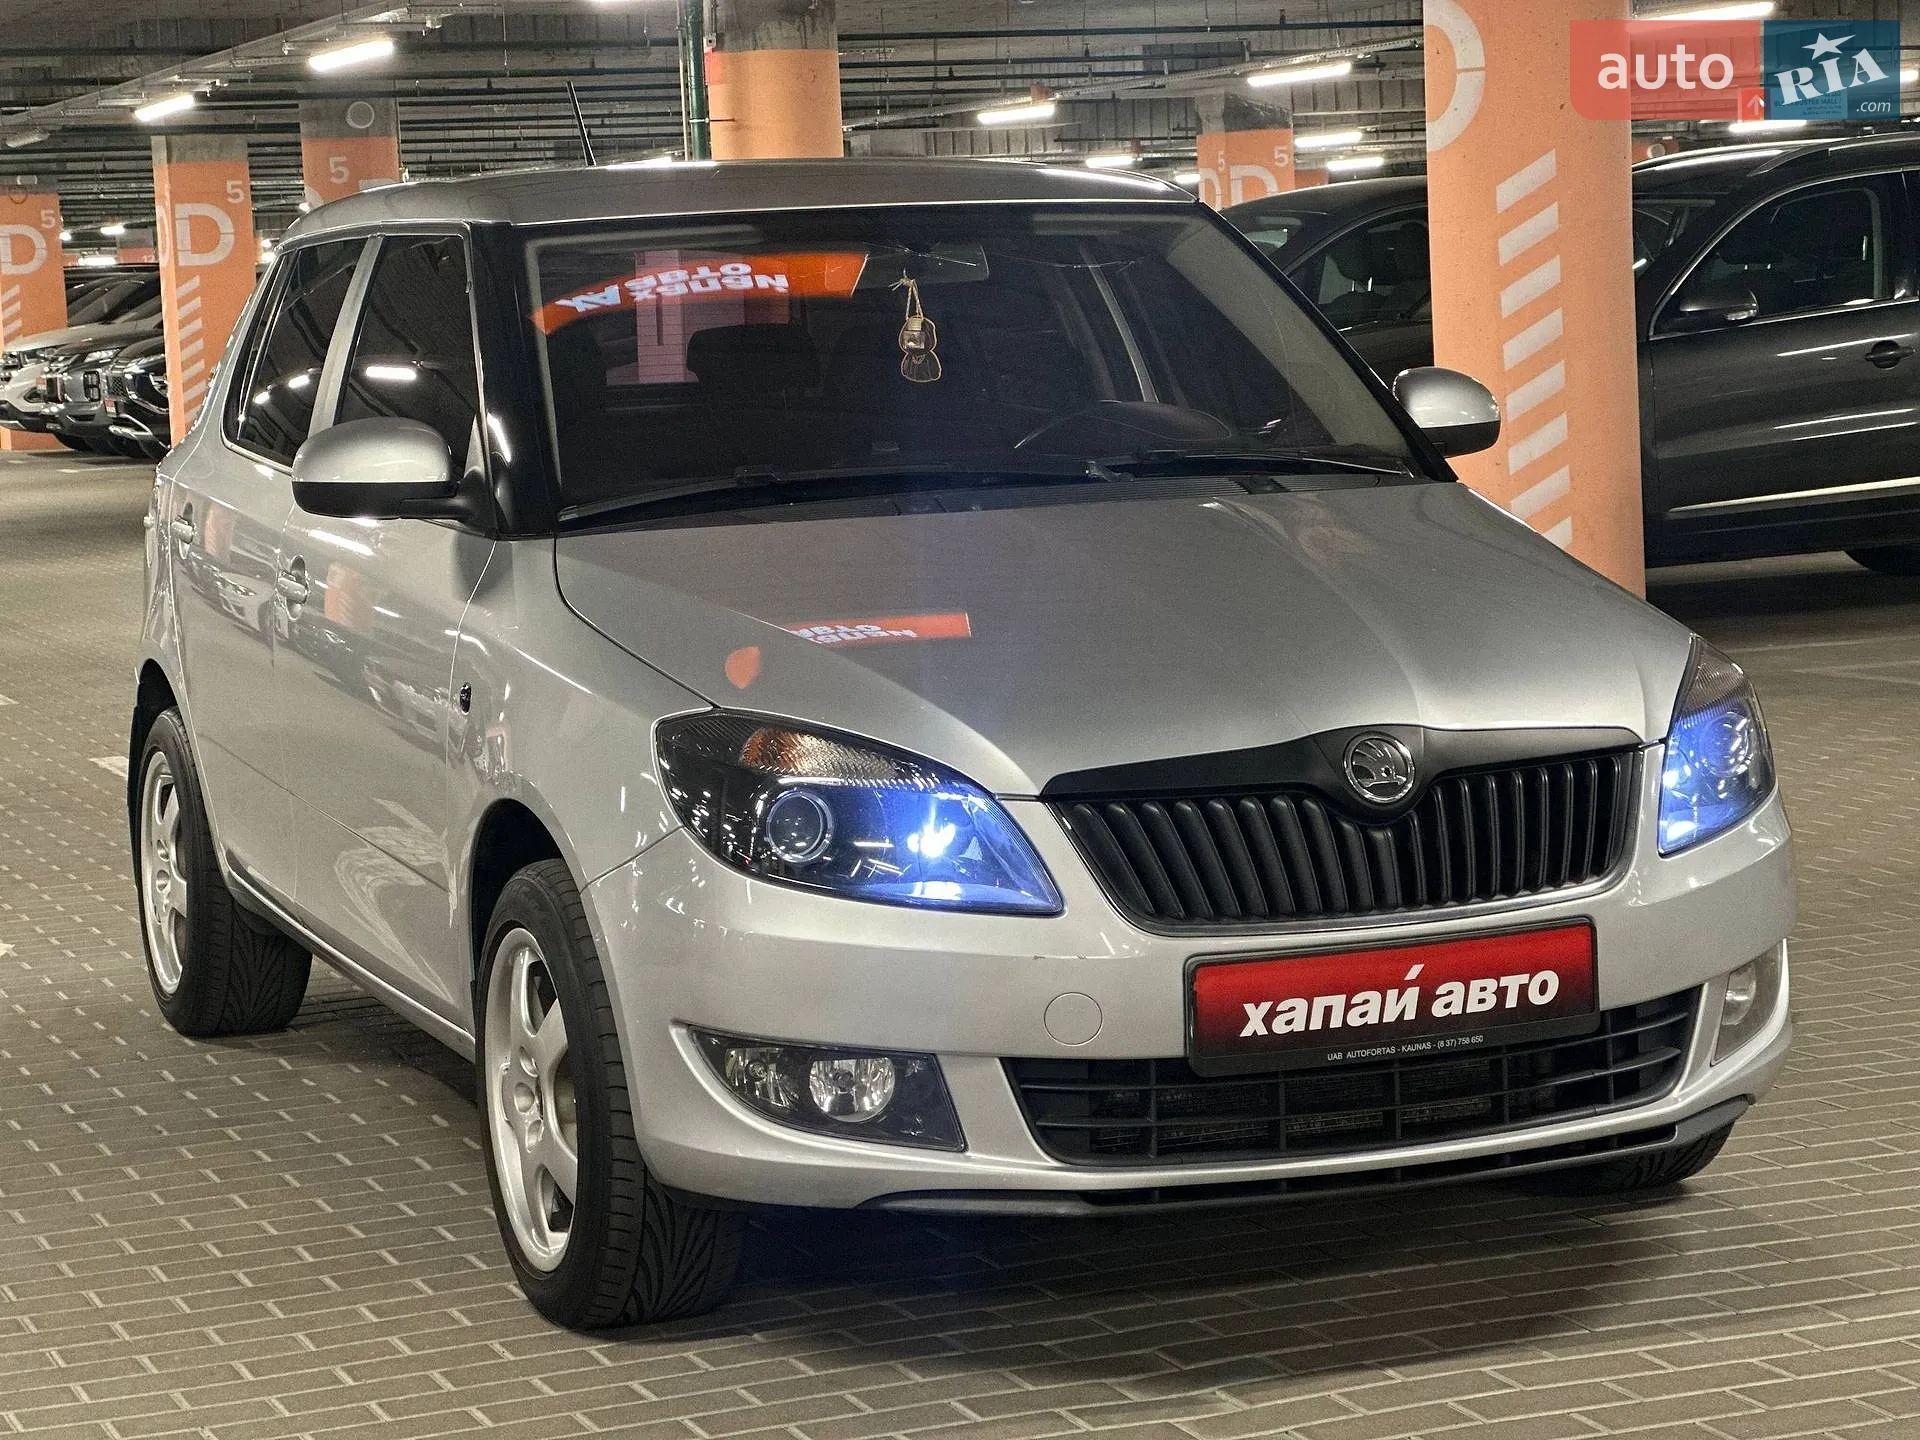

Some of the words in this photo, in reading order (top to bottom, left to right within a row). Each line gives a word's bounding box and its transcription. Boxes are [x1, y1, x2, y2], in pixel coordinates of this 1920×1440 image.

[328, 155, 350, 185] 5
[1274, 146, 1289, 167] 5
[226, 180, 245, 205] 5
[40, 209, 56, 229] 5
[175, 203, 235, 267] D
[0, 224, 48, 274] D
[1239, 963, 1426, 1038] хапай
[1430, 969, 1560, 1019] авто
[1327, 1052, 1343, 1061] UAB
[1346, 1046, 1396, 1059] AUTOFORTAS
[1401, 1041, 1432, 1053] KAUNAS
[1445, 1038, 1457, 1048] 37)
